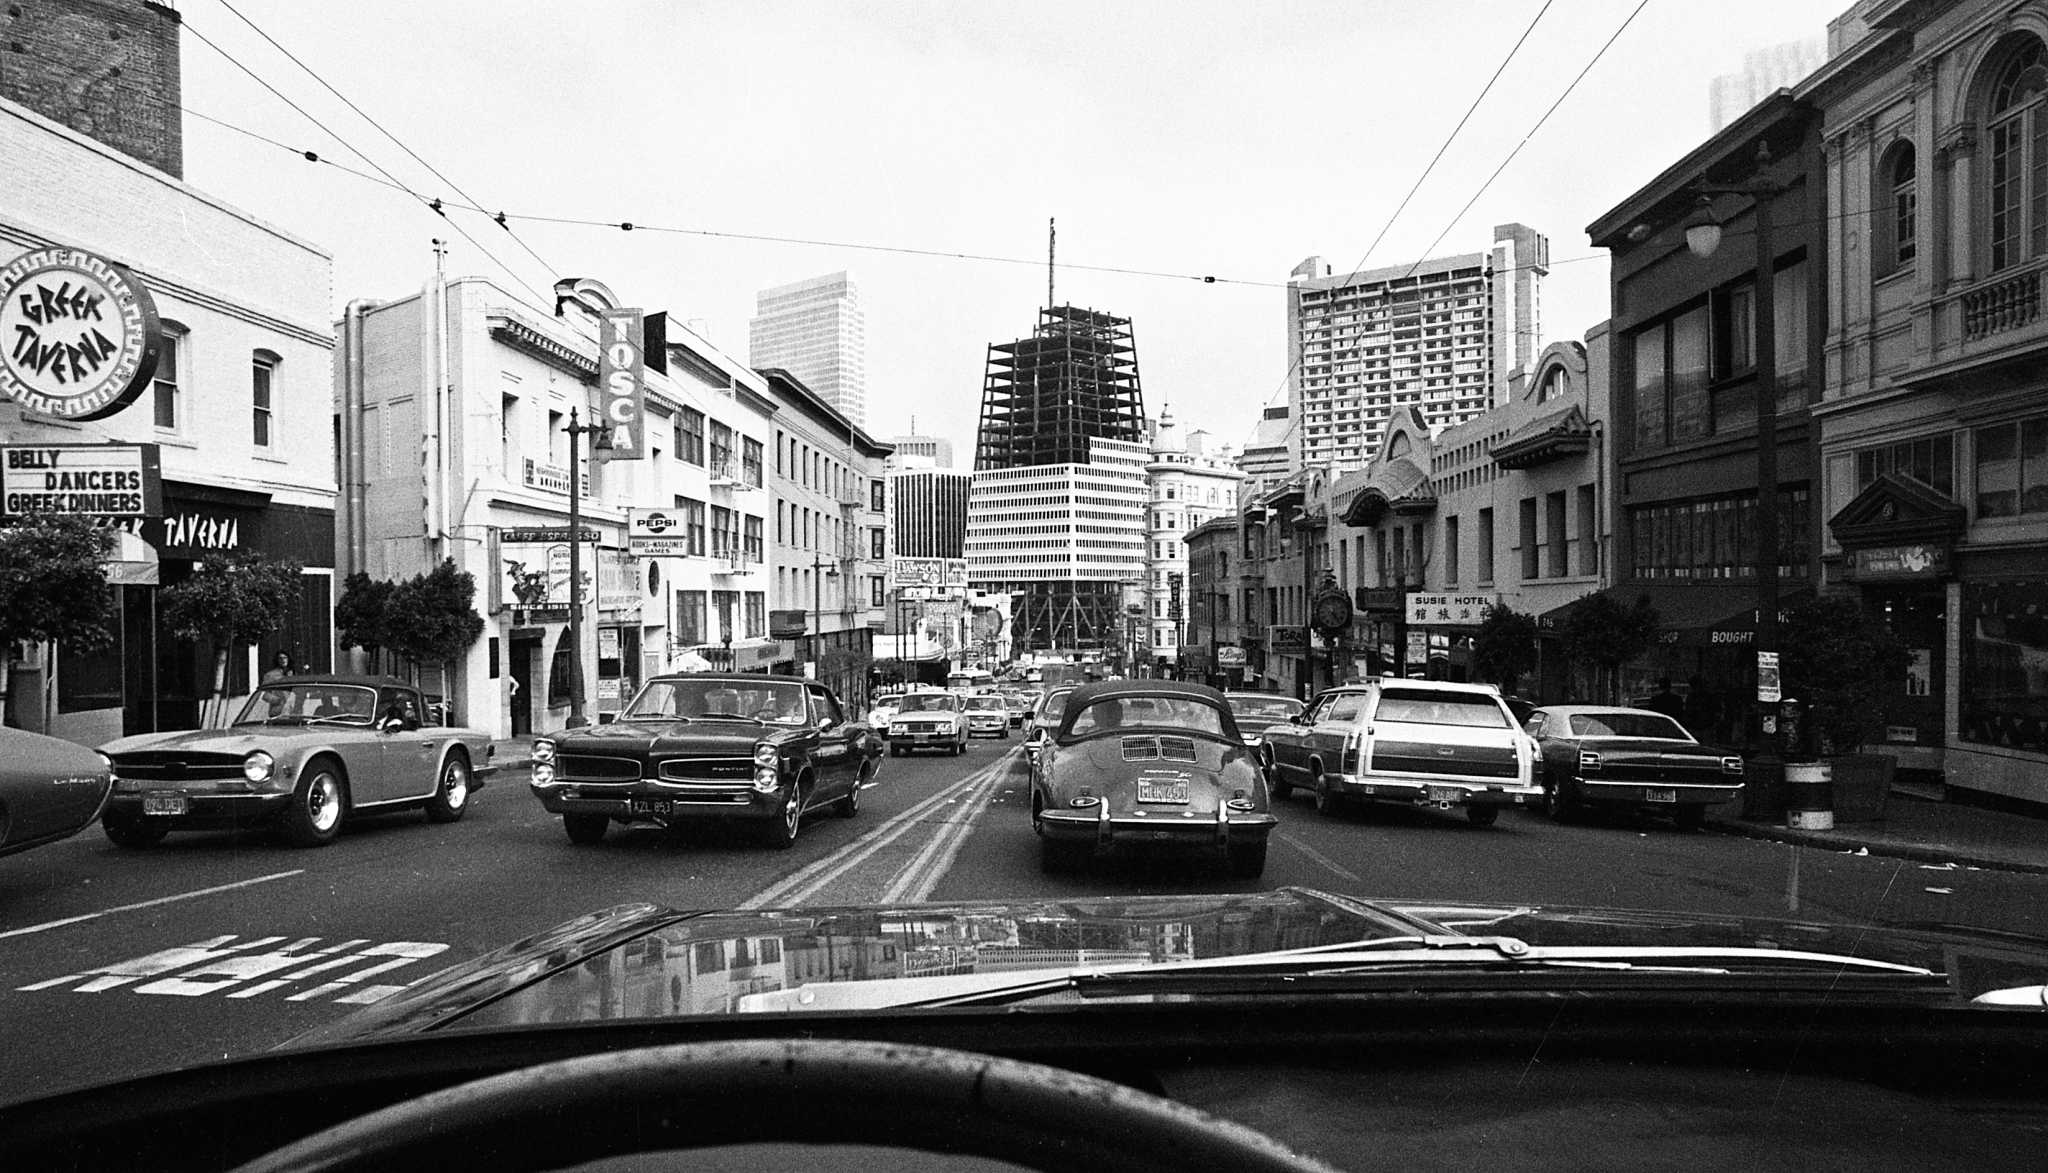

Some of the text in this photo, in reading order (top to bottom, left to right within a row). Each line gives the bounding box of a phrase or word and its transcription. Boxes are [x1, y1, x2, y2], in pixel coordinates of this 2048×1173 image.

[20, 281, 105, 326] GREEK
[12, 324, 118, 384] TAVERNA
[608, 317, 635, 449] TOSCA
[8, 450, 61, 469] BELLY
[45, 470, 140, 490] DANCERS
[8, 493, 142, 512] GREEK DINNERS
[164, 512, 239, 549] TAVERNA
[1415, 597, 1490, 605] SUSIE HOTEL
[1711, 631, 1755, 643] BOUGHT
